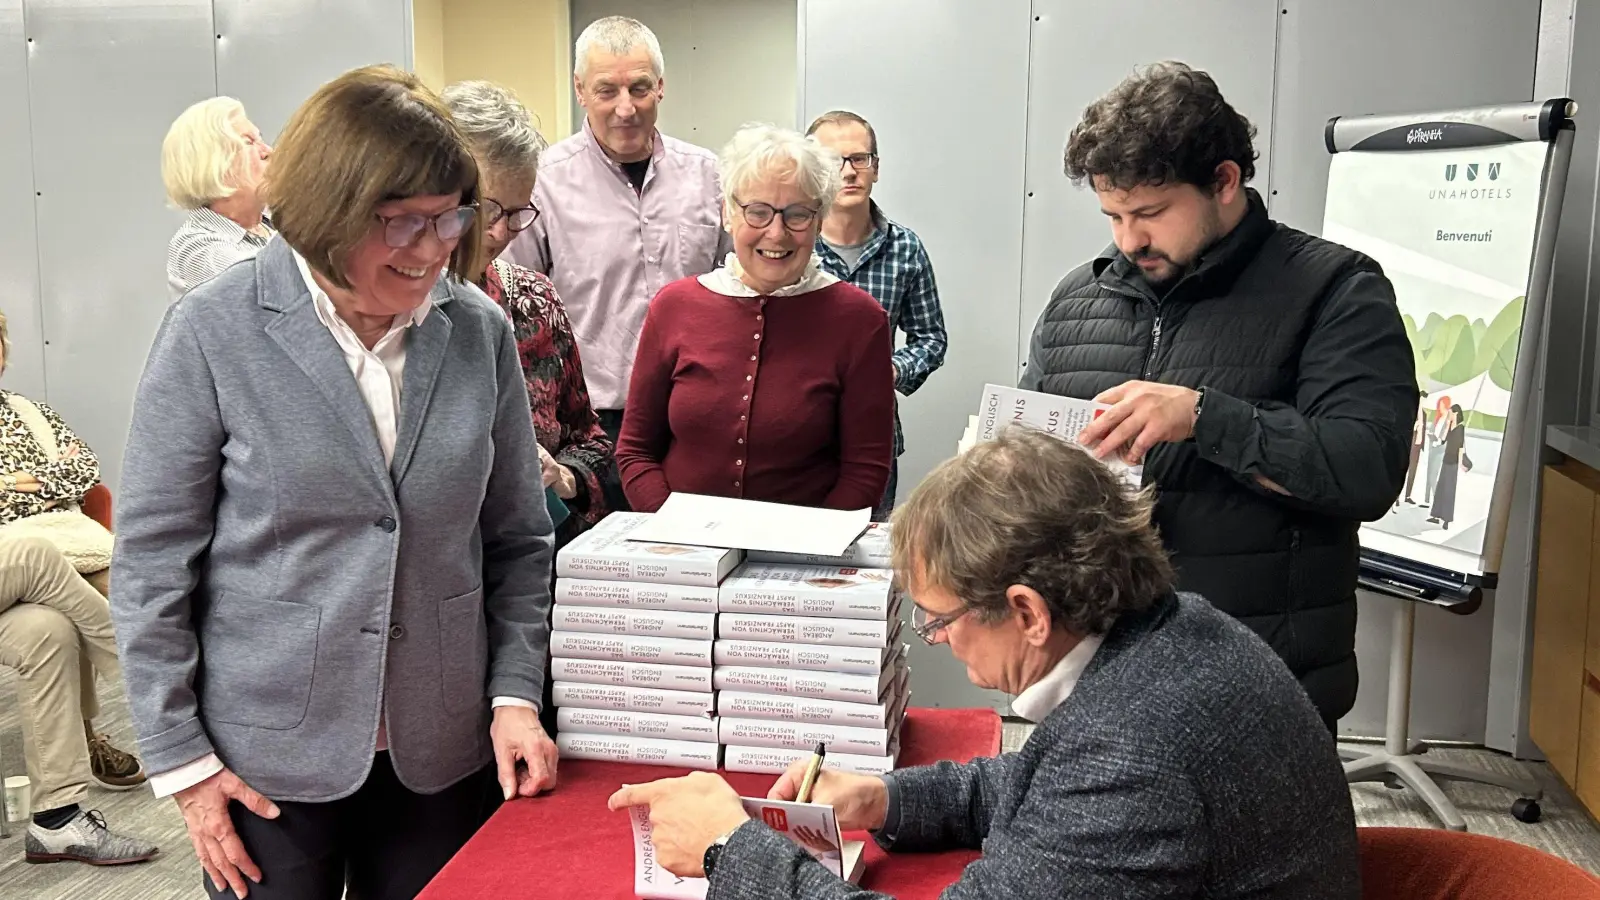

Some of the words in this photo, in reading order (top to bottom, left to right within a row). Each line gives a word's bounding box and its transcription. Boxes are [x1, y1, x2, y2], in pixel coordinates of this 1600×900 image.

[1429, 188, 1512, 199] UNAHOTELS
[1436, 230, 1492, 242] Benvenuti
[984, 394, 998, 440] ENGLISCH
[642, 834, 652, 883] ANDREAS
